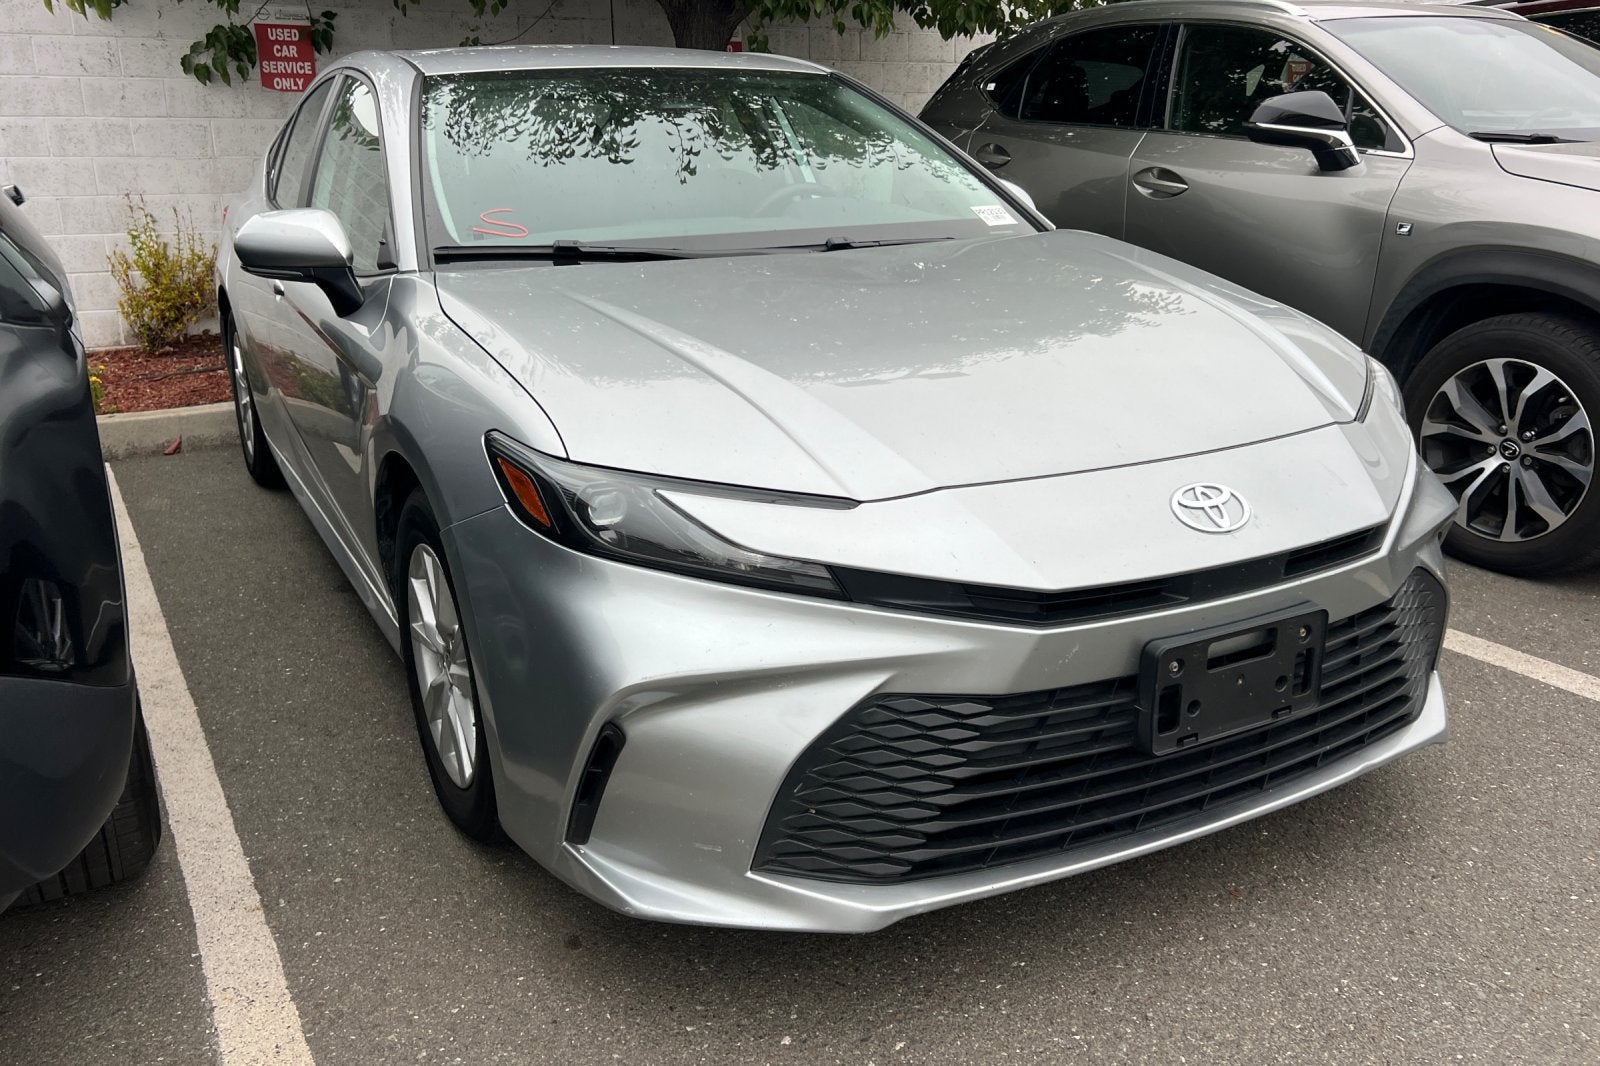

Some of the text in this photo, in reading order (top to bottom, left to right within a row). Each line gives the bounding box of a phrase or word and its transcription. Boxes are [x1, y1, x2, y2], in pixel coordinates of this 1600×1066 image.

[268, 28, 299, 41] USED
[274, 44, 298, 57] CAR
[262, 60, 312, 74] SERVICE
[274, 77, 304, 90] ONLY
